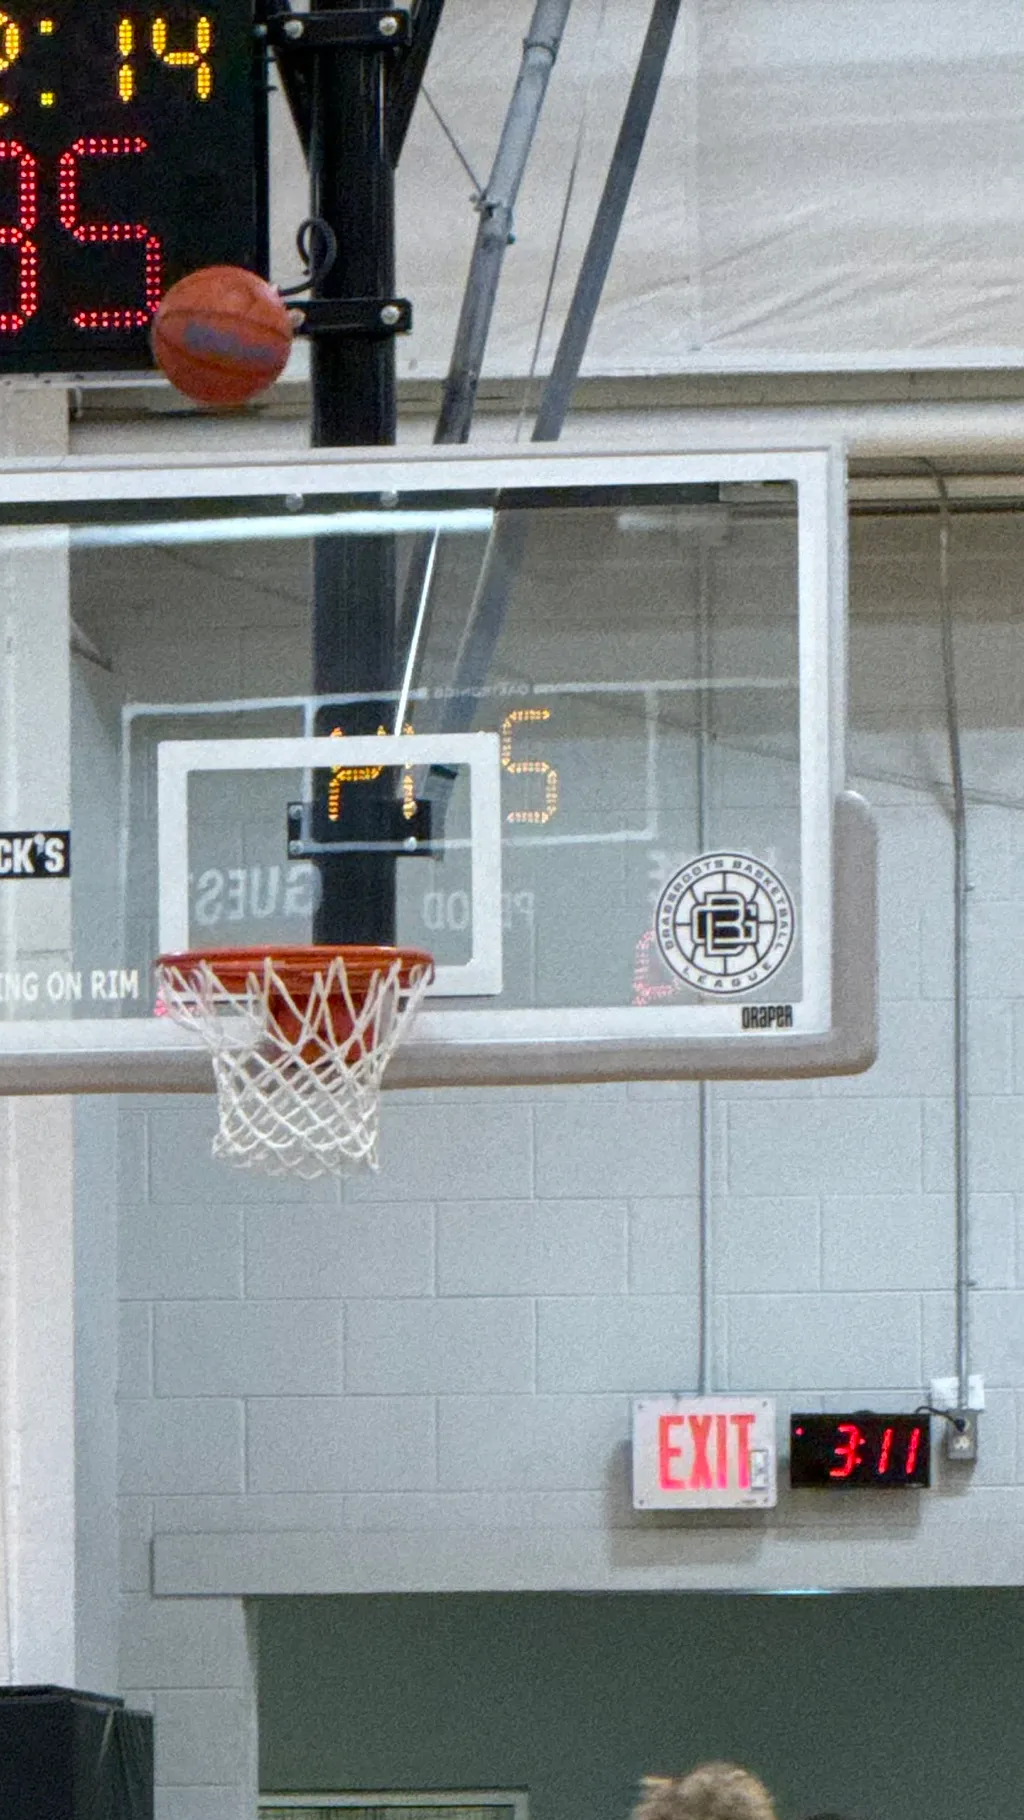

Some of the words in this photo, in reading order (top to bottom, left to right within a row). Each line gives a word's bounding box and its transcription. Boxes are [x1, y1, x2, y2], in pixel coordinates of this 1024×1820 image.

[47, 971, 82, 1000] ON
[91, 969, 138, 999] RIM
[682, 962, 772, 989] LEAGUE
[659, 1414, 755, 1489] EXIT
[830, 1425, 920, 1477] 3:11
